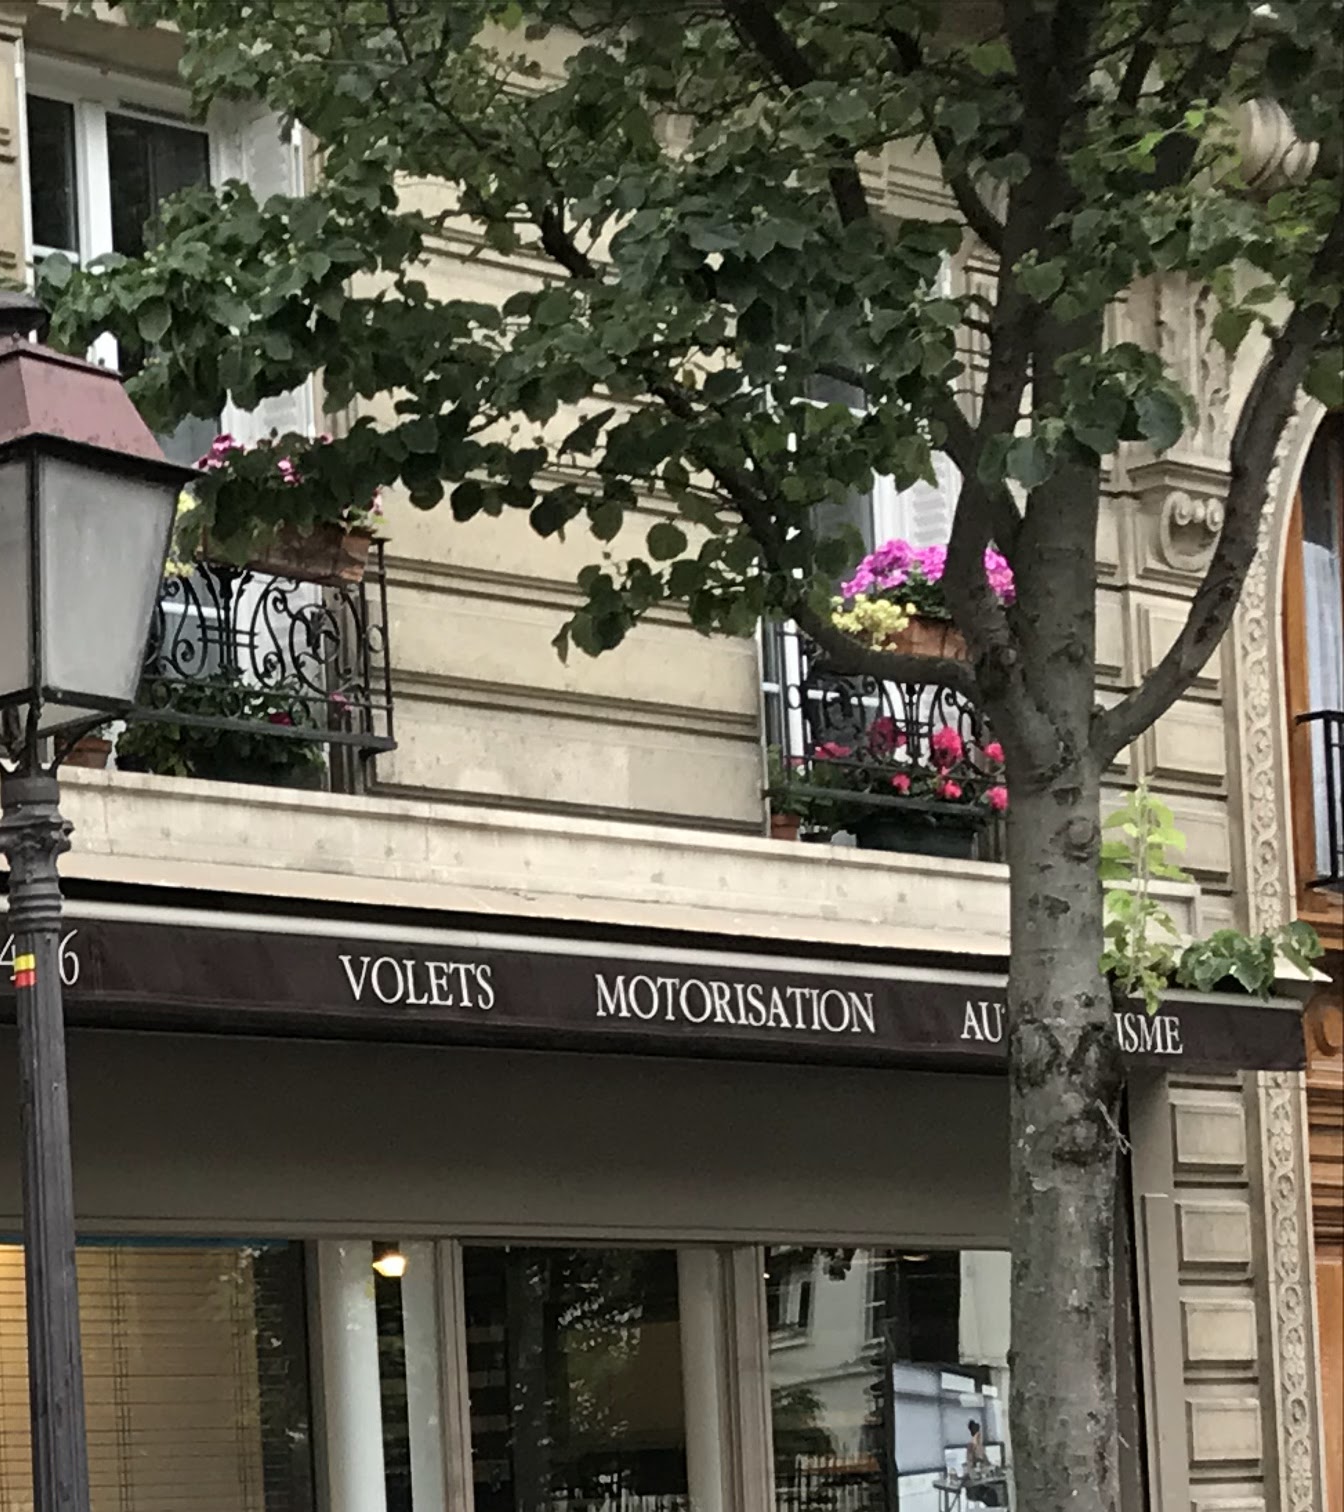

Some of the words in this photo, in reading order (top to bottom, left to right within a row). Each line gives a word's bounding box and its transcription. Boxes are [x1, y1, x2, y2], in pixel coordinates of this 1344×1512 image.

[338, 954, 497, 1011] VOLETS
[593, 973, 876, 1035] MOTORISATION
[960, 1000, 1183, 1054] AUISME
